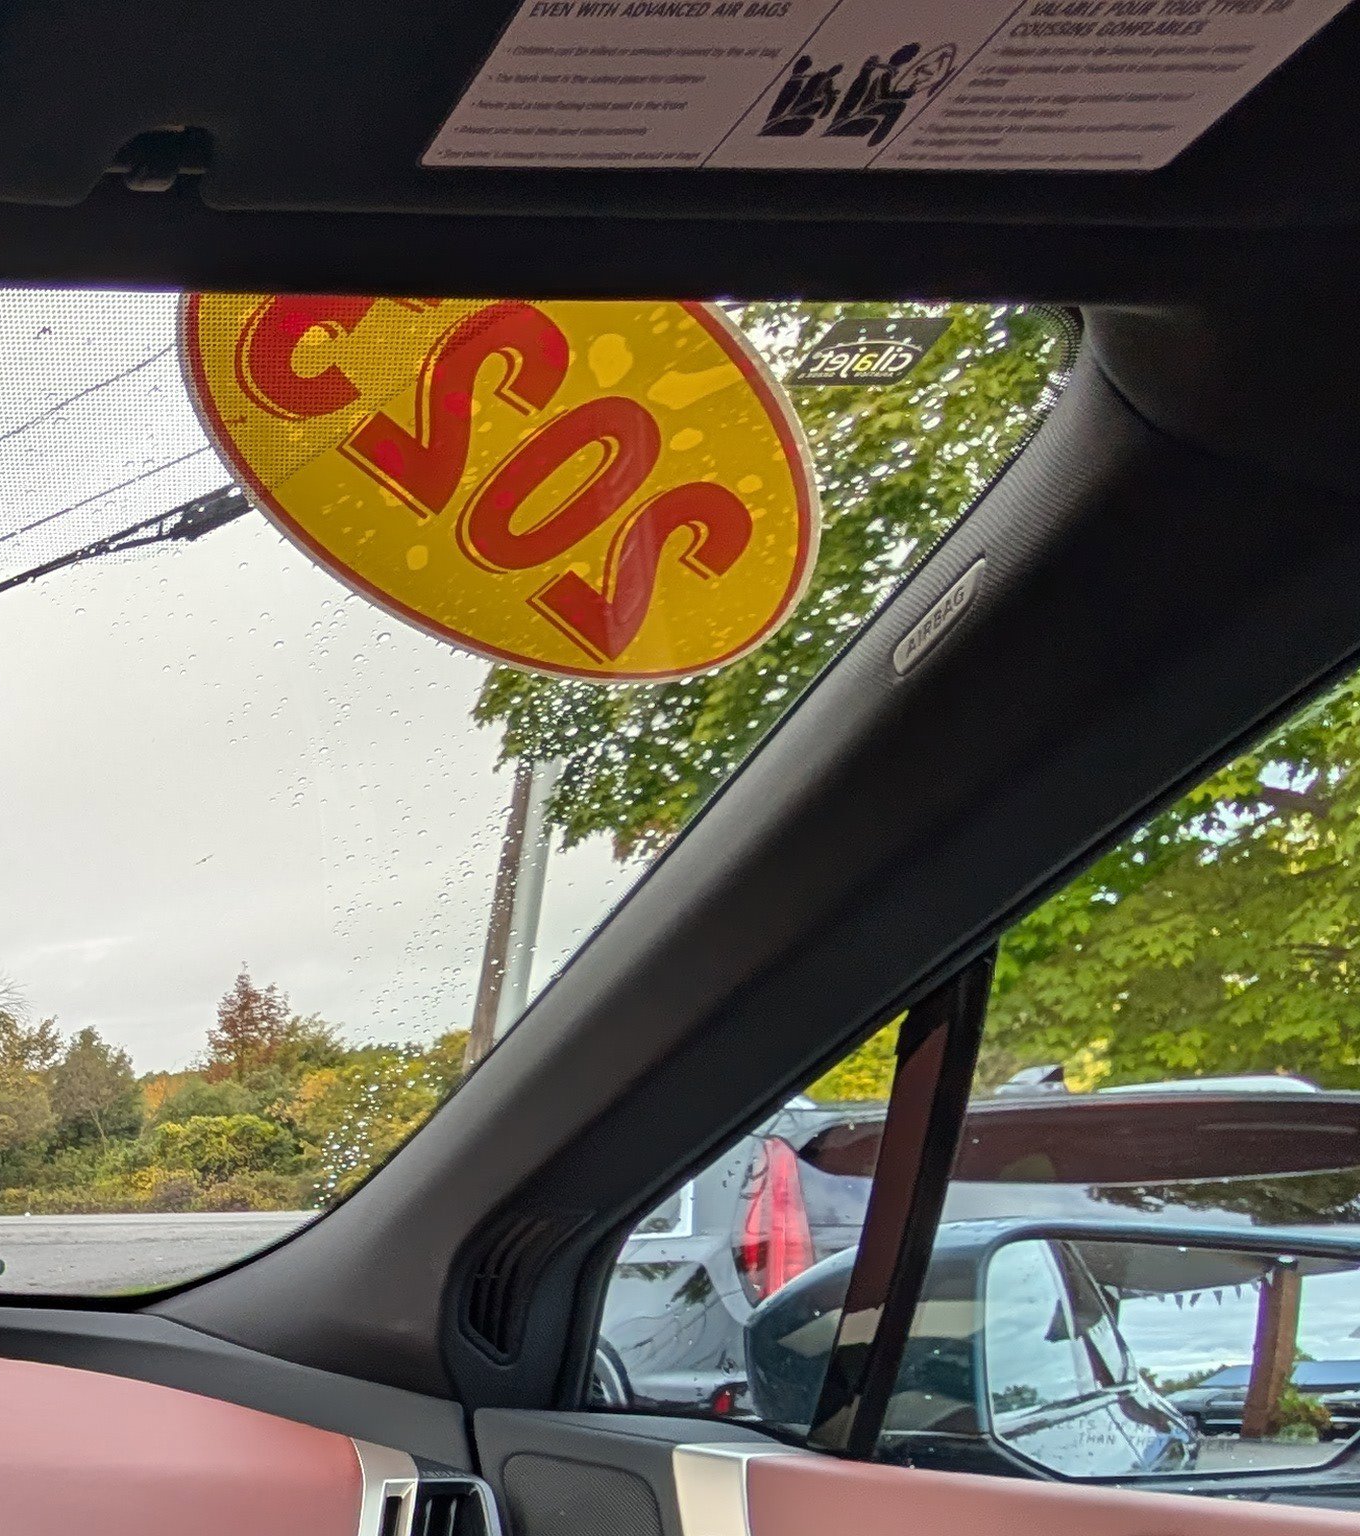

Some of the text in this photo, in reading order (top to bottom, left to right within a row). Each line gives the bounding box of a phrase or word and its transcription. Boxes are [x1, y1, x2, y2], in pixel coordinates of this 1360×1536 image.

[529, 2, 793, 17] EVEN WITH ADVANCED AIR BAGS
[906, 586, 966, 658] AIRBAG
